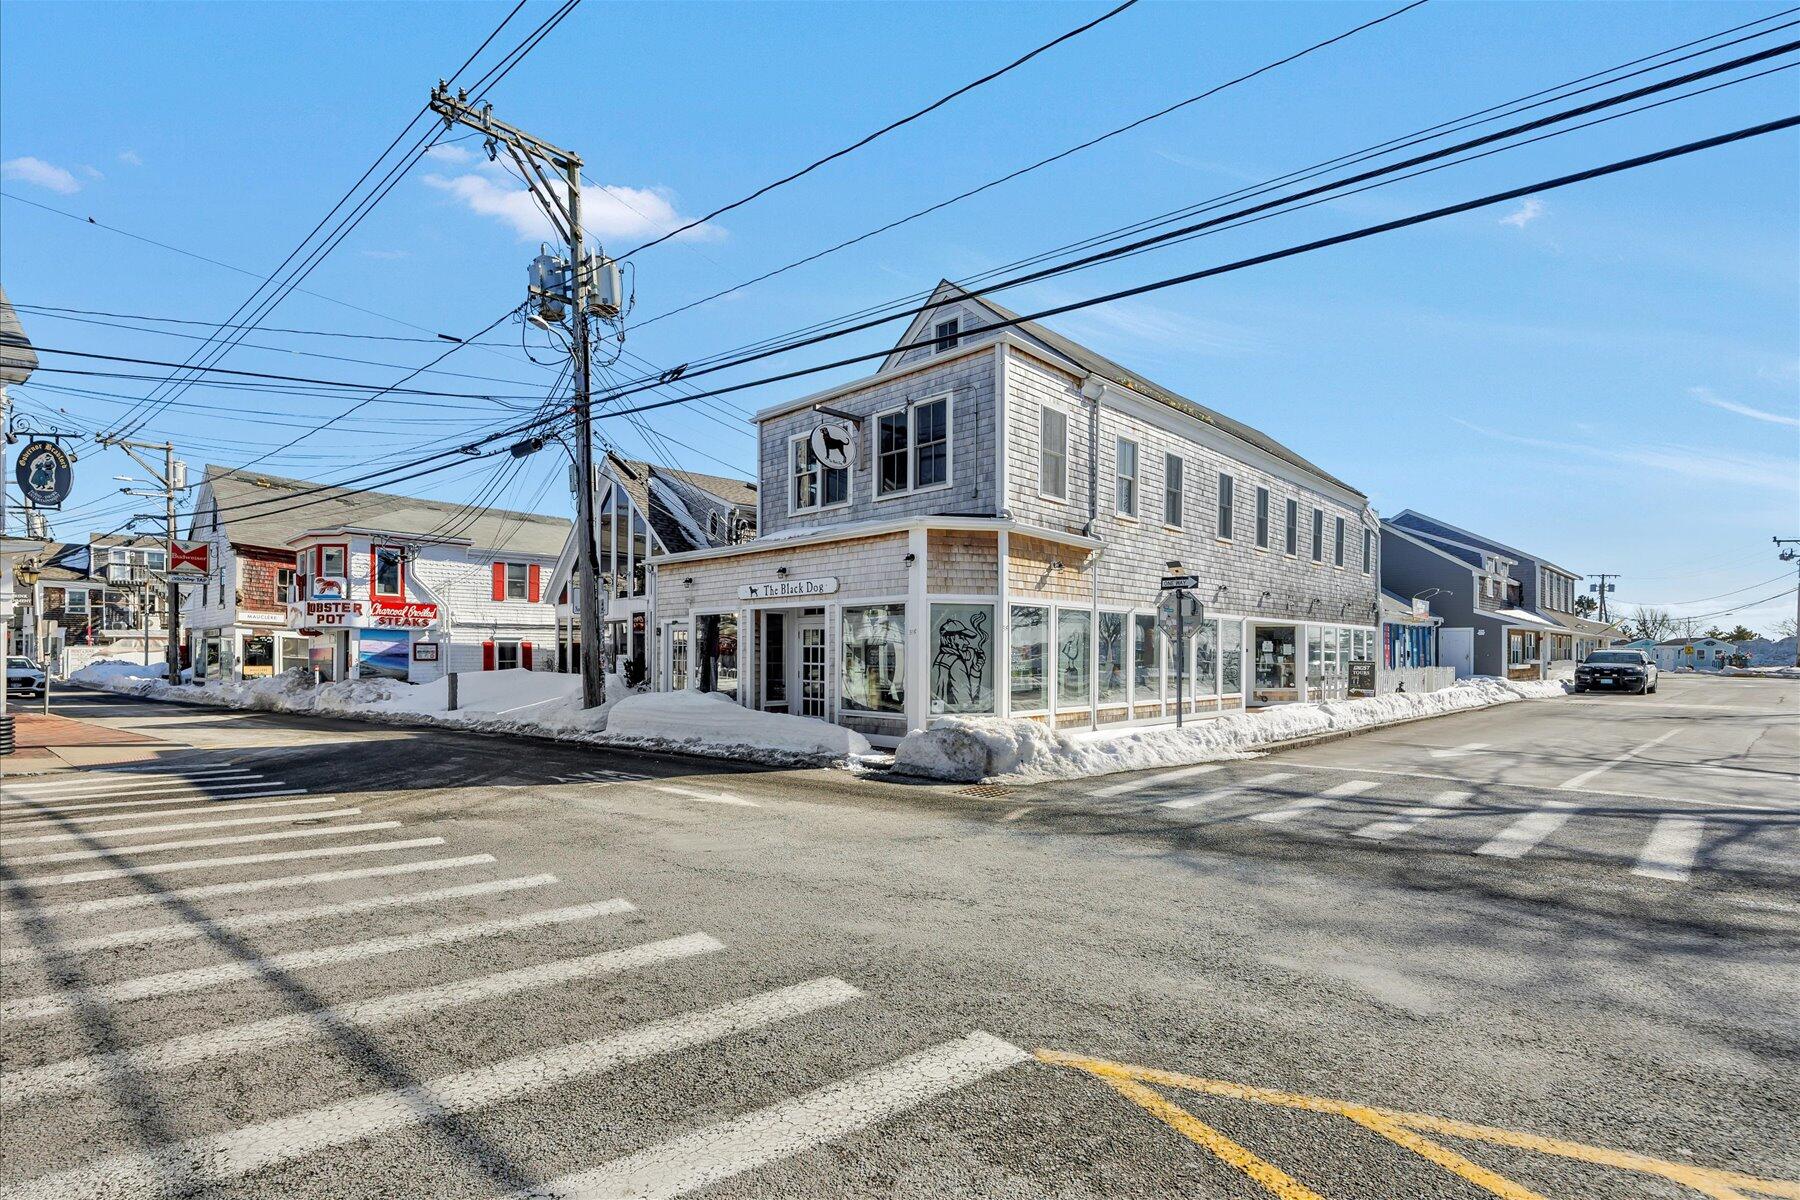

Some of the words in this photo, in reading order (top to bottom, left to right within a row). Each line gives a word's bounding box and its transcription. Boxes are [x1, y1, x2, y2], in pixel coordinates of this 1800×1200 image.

[45, 443, 67, 469] Bradford
[171, 552, 207, 561] Budweiser
[763, 585, 778, 596] The
[780, 583, 804, 595] Black
[806, 581, 824, 593] Dog
[306, 602, 363, 616] LOBSTER
[369, 602, 409, 618] Charcoal
[408, 605, 437, 618] Broiled
[316, 614, 345, 624] POT
[378, 616, 430, 627] STEAKS
